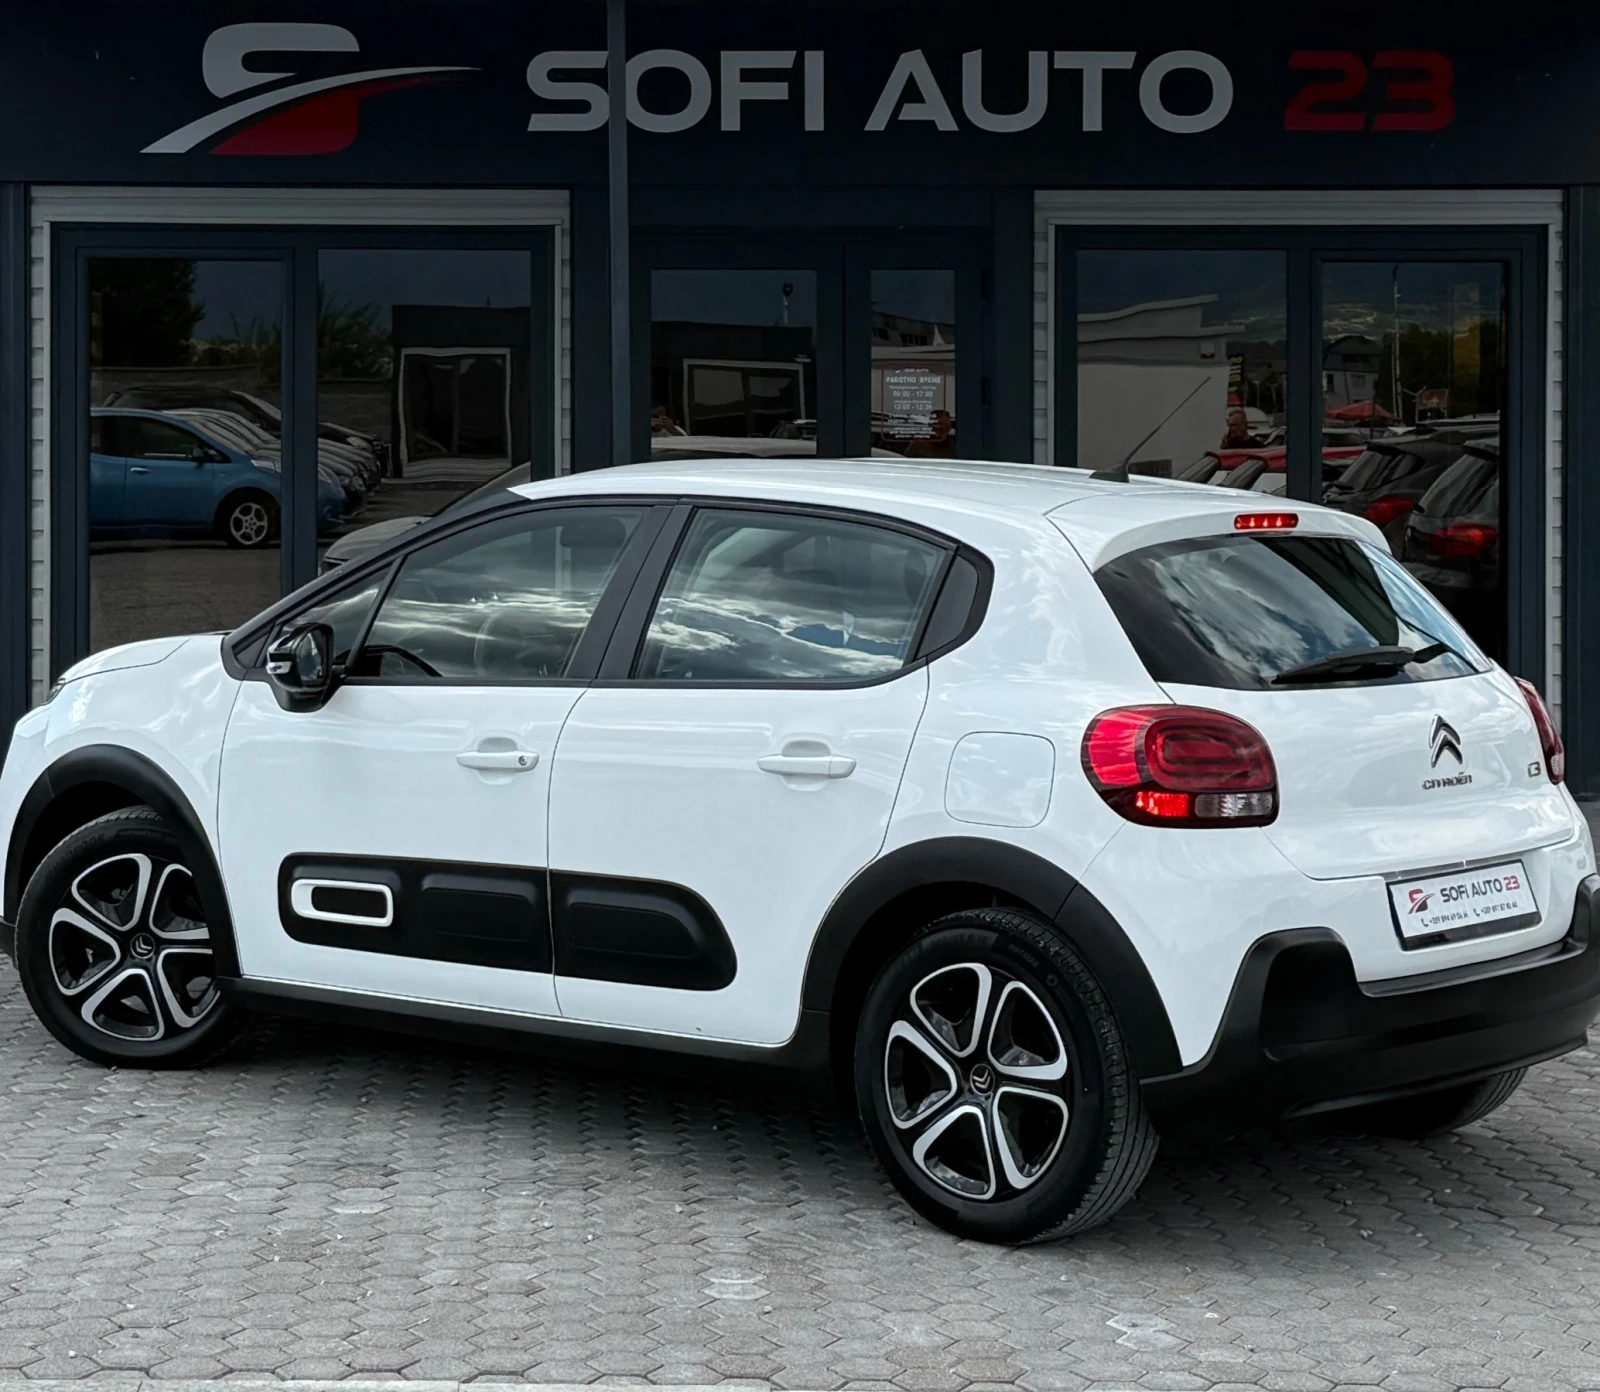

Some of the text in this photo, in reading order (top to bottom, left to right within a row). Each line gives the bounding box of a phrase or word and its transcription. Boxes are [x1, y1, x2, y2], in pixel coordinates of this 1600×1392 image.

[526, 49, 1456, 134] SOFI AUTO 23
[1440, 876, 1521, 903] SOFI AUTO 23
